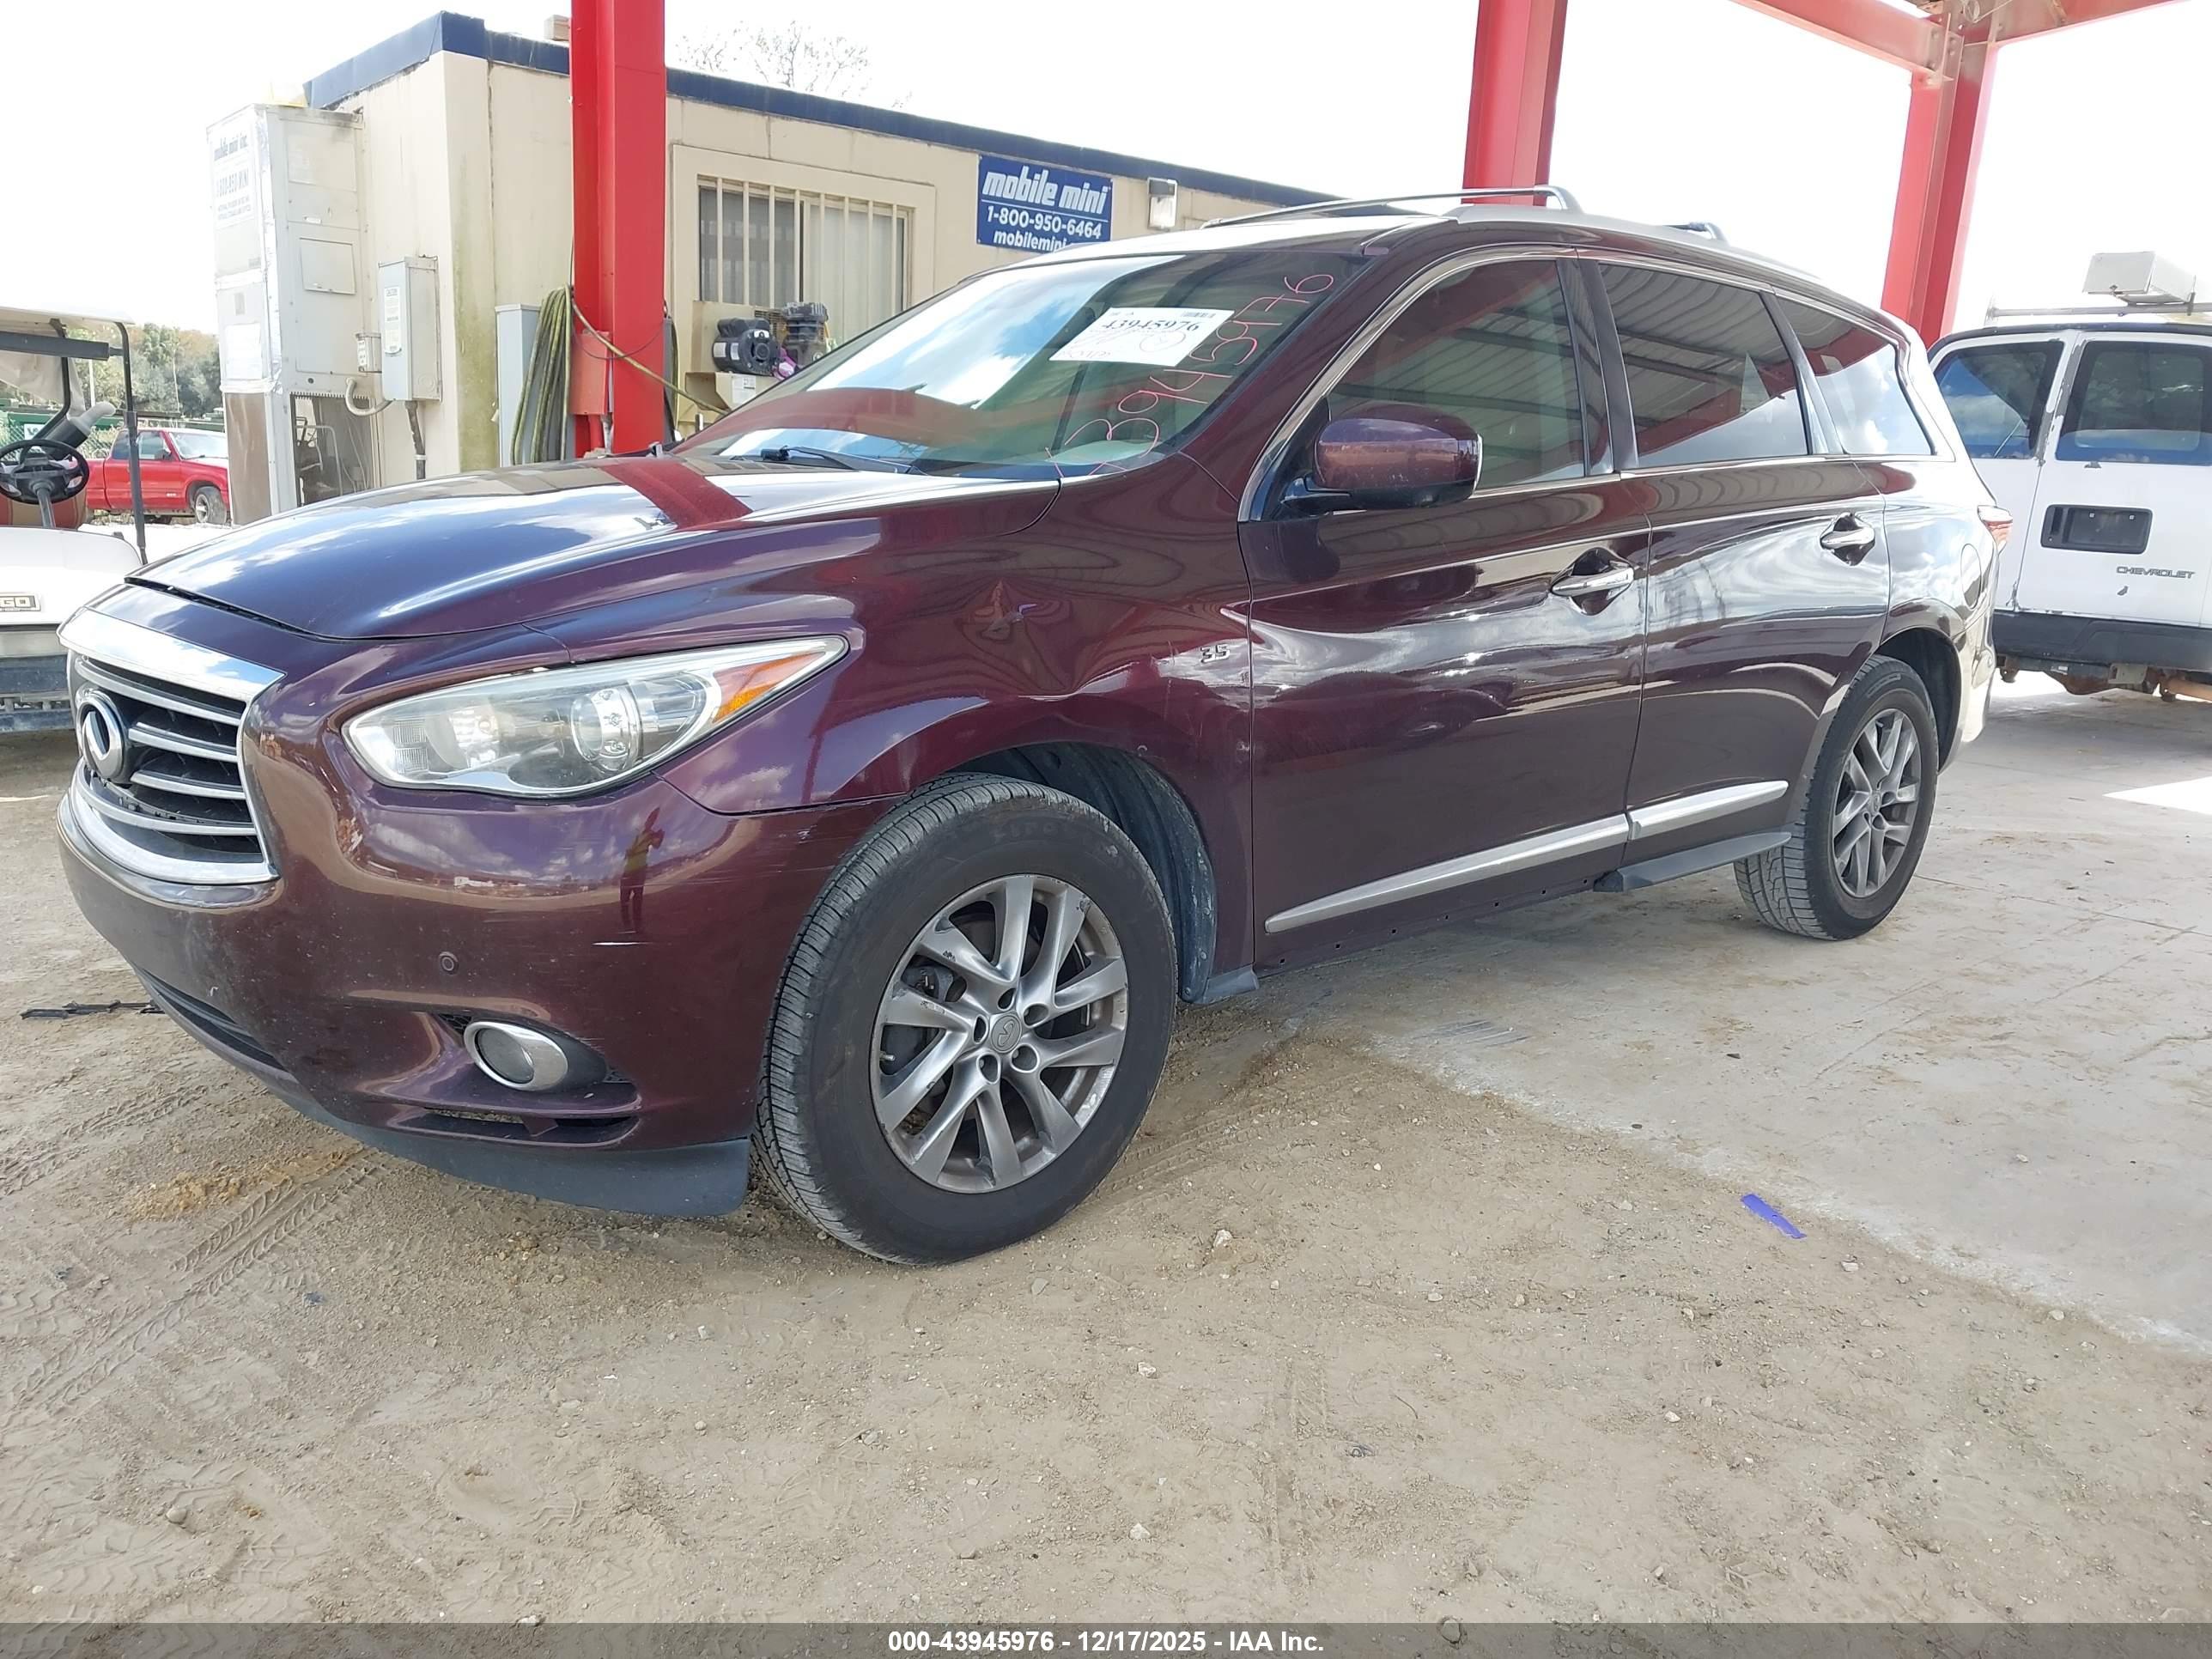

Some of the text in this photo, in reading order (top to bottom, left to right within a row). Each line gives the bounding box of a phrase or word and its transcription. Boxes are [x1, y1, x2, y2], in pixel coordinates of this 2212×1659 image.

[981, 166, 1109, 215] mobile mini
[987, 205, 1103, 240] 1-800-950-6464
[1101, 319, 1200, 332] 43945976
[2116, 566, 2197, 579] CHEVROLET
